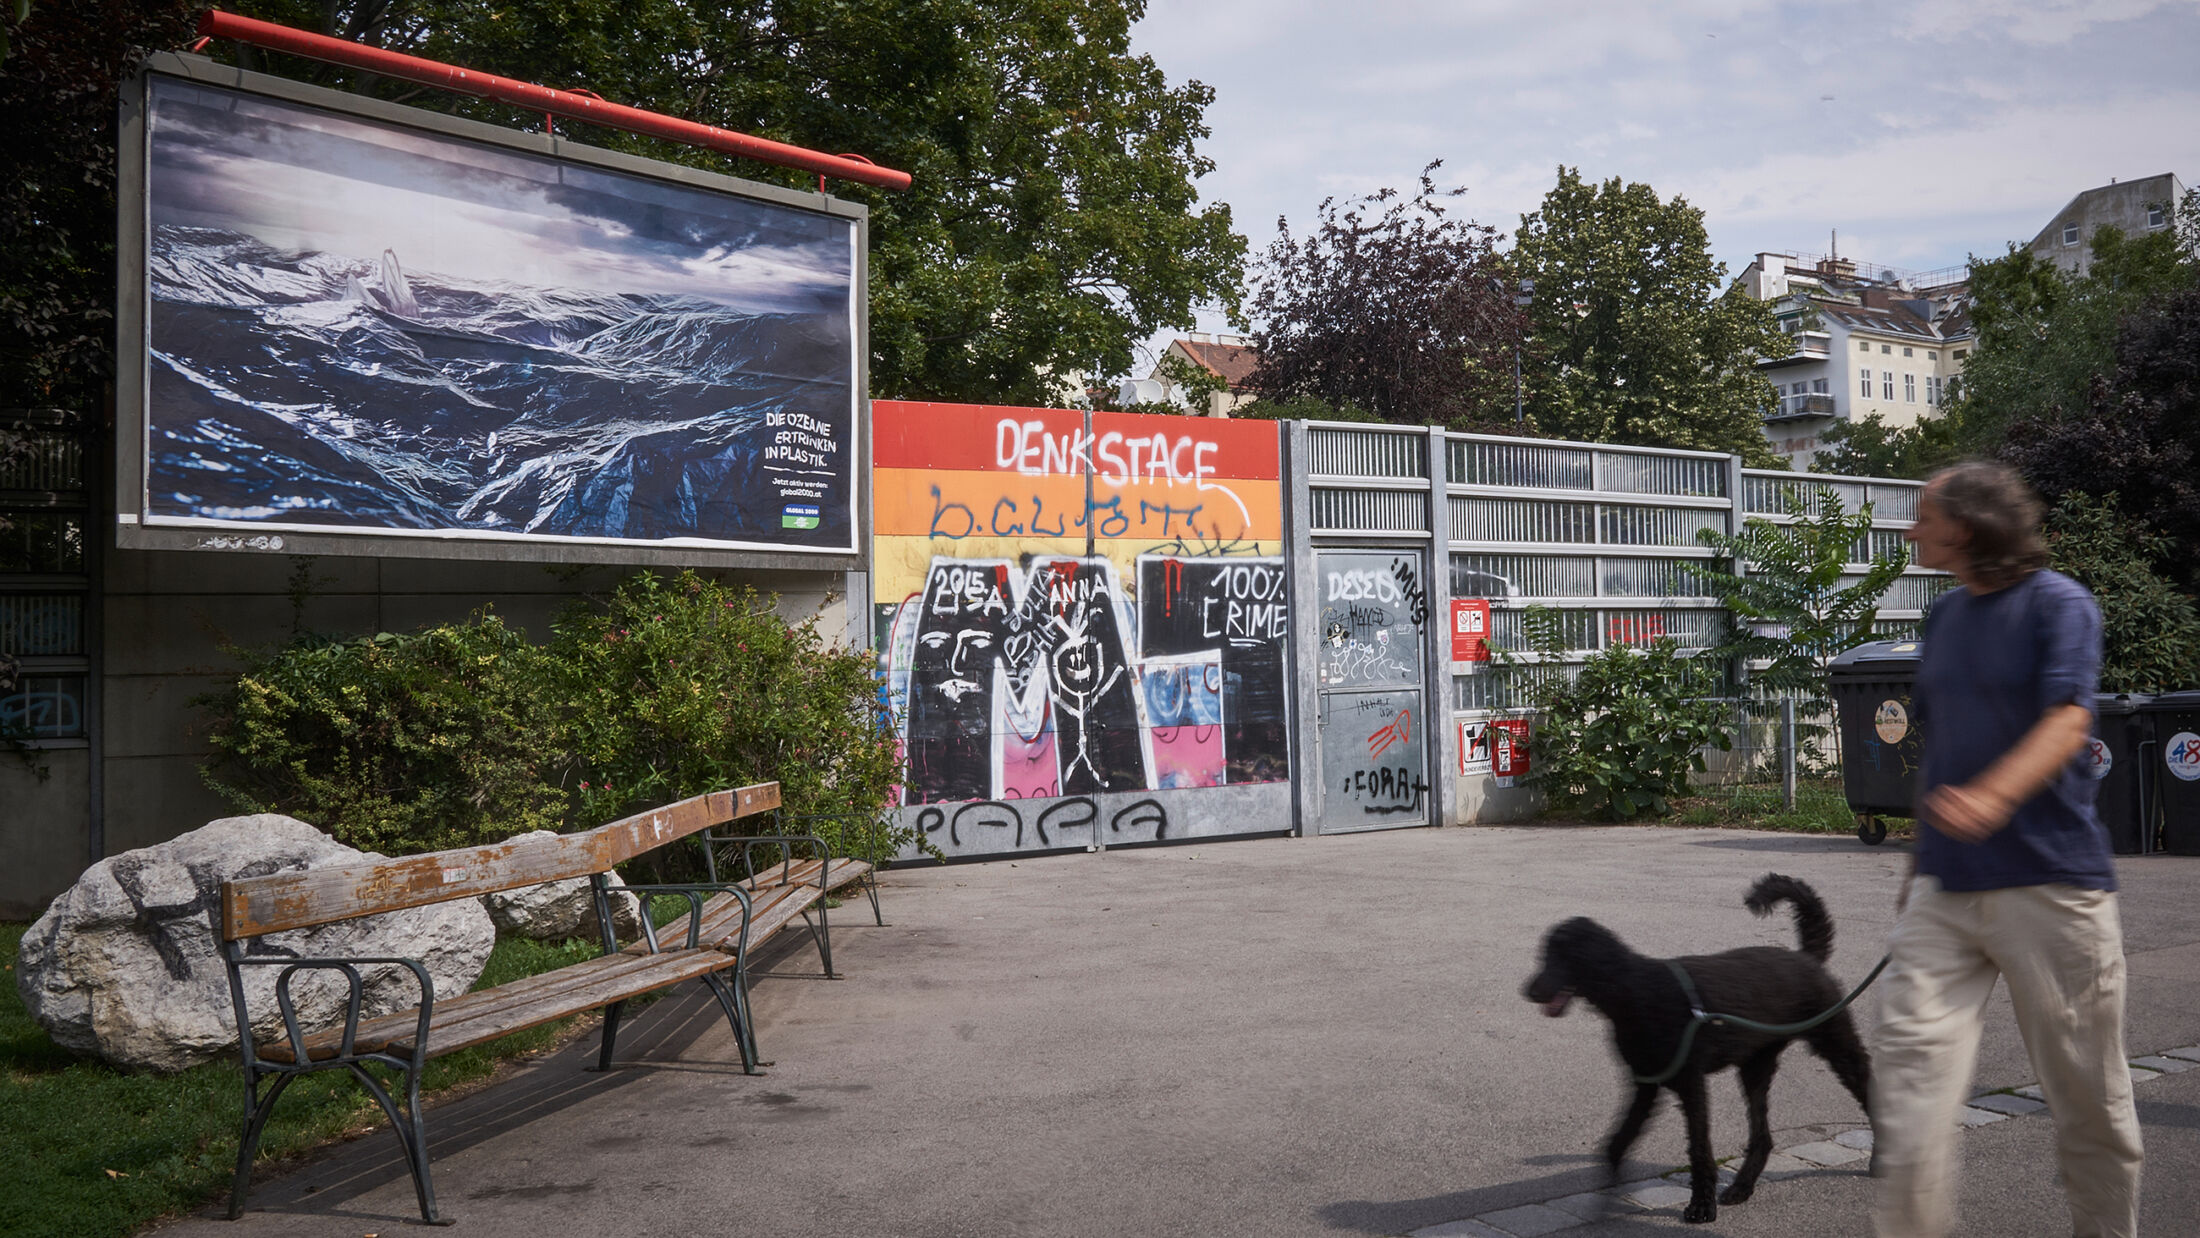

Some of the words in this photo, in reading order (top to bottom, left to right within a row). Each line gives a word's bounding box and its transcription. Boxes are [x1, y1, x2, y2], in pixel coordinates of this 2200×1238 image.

[766, 412, 786, 427] DIE
[787, 413, 831, 437] OZEANE
[775, 430, 837, 453] ERTRINKEN
[765, 446, 778, 459] IN
[780, 446, 828, 467] PLASTIK.
[772, 478, 789, 486] Jetzt
[789, 480, 804, 488] aktiv
[780, 488, 822, 498] global2000.at
[1050, 573, 1110, 615] ANNA
[1211, 566, 1285, 601] 100%
